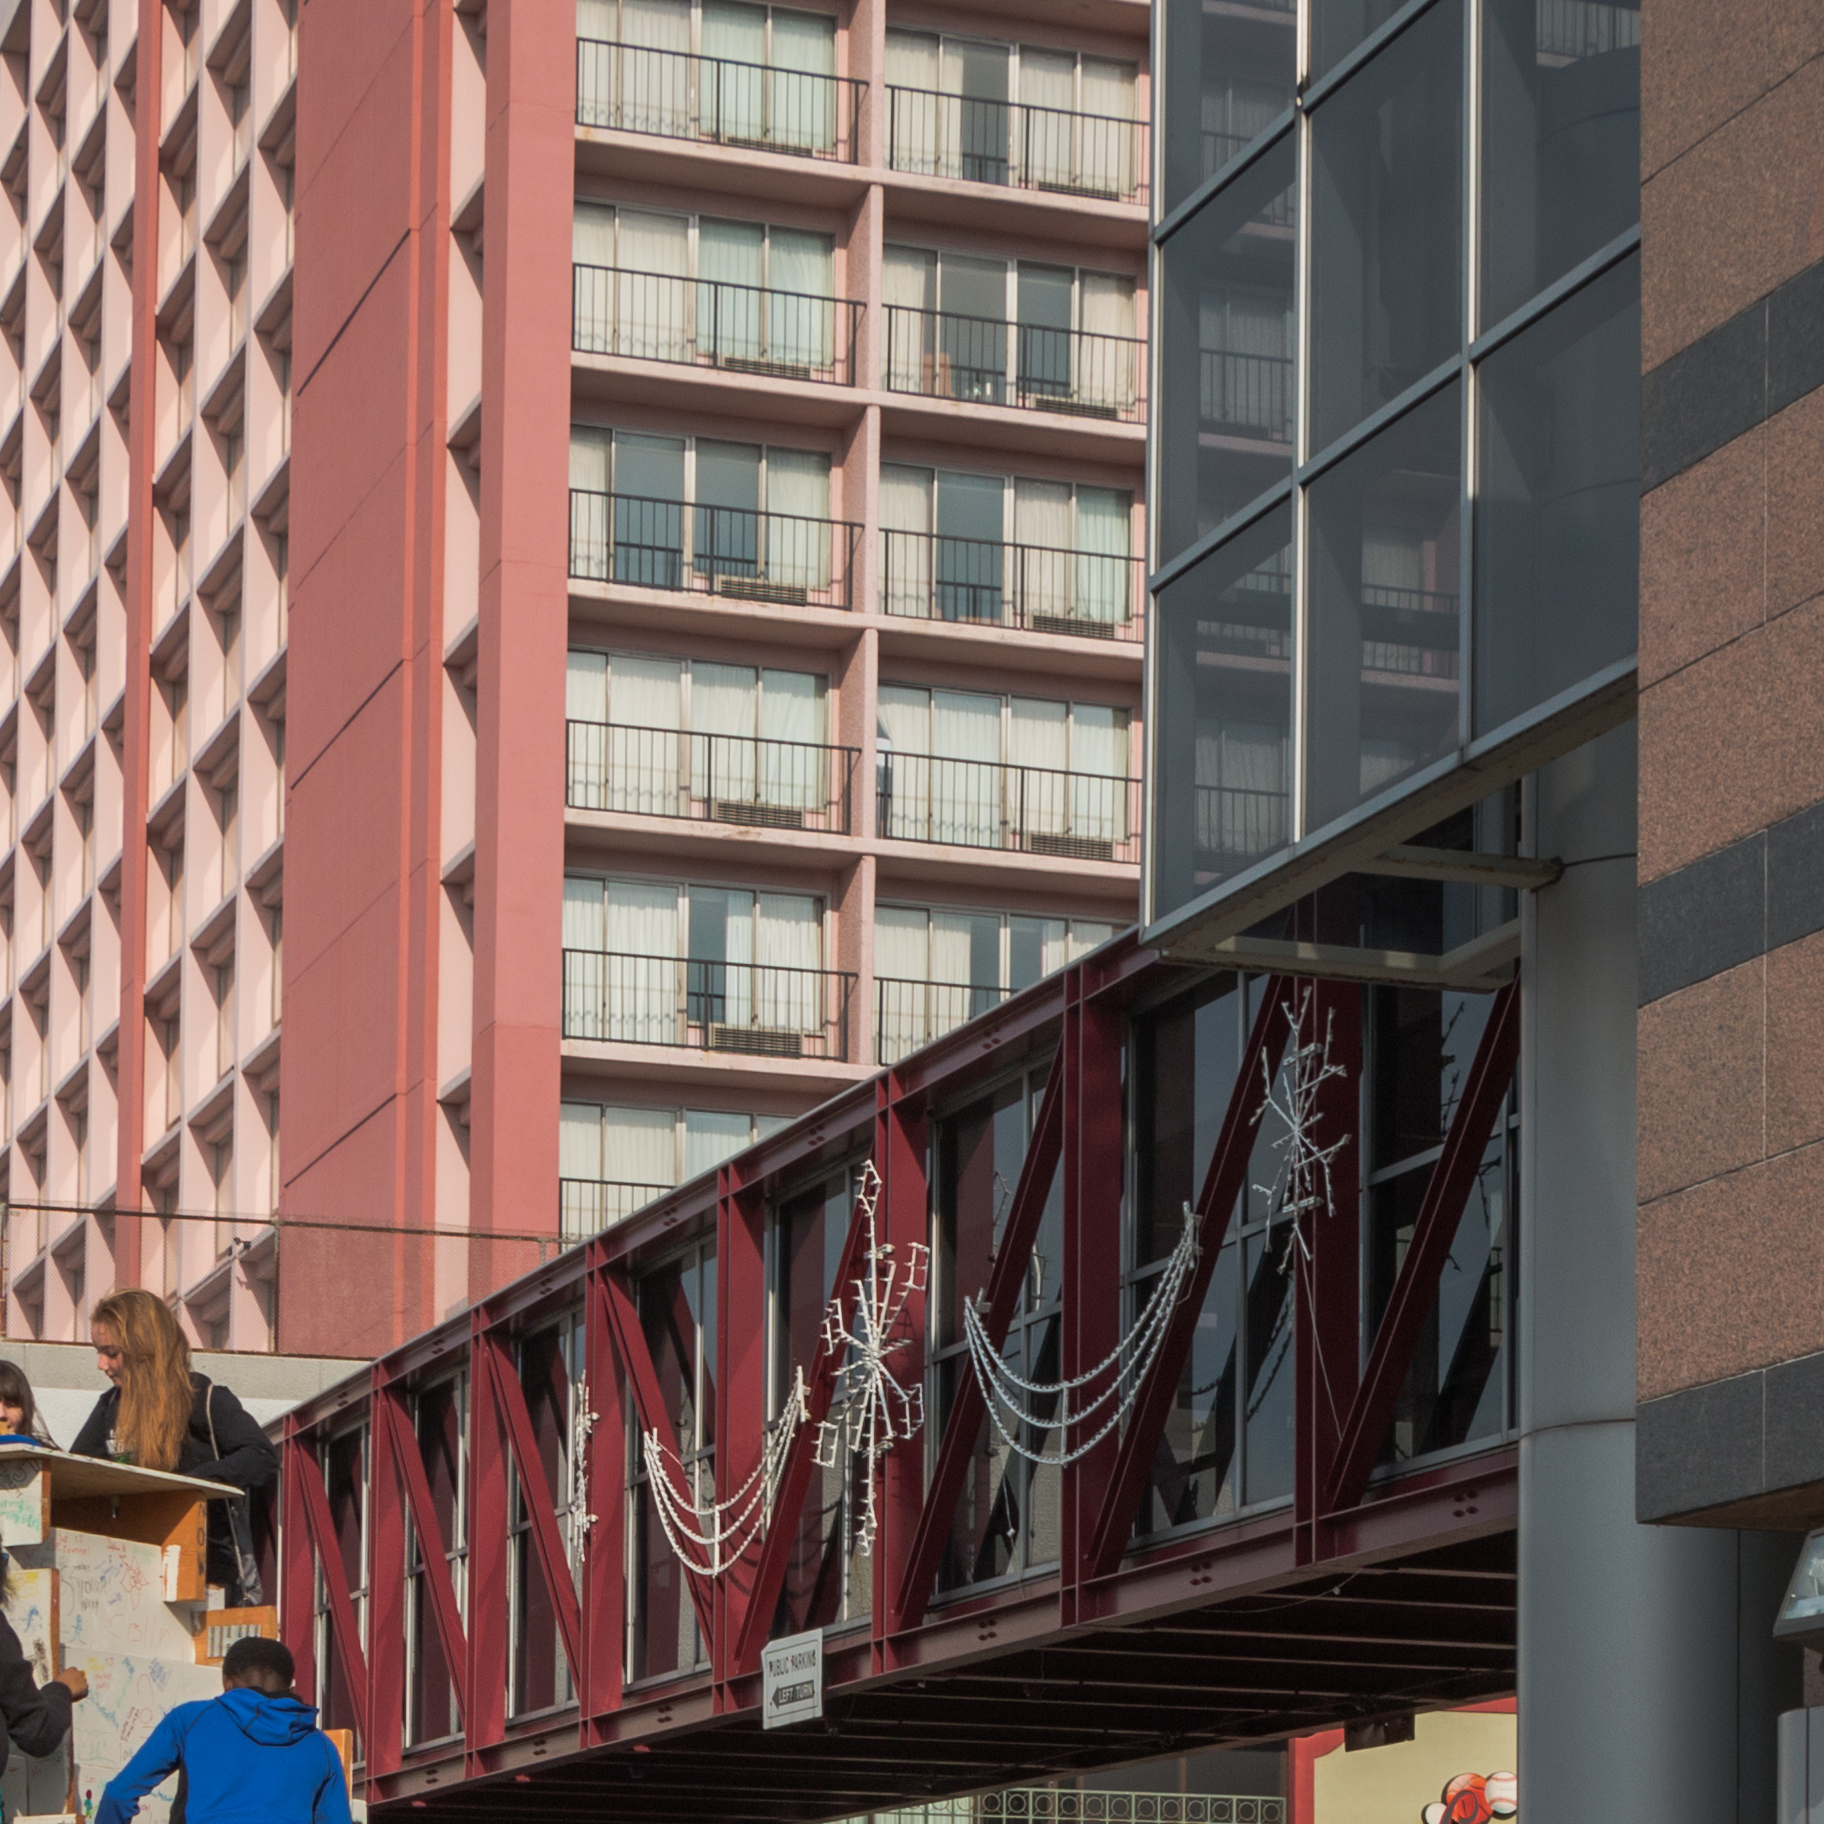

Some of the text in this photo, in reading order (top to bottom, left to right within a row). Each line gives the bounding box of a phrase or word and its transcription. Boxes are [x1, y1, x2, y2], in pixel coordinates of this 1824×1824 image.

[768, 1649, 816, 1677] PUBLIC PARKING
[779, 1682, 815, 1703] LEFT TURN
